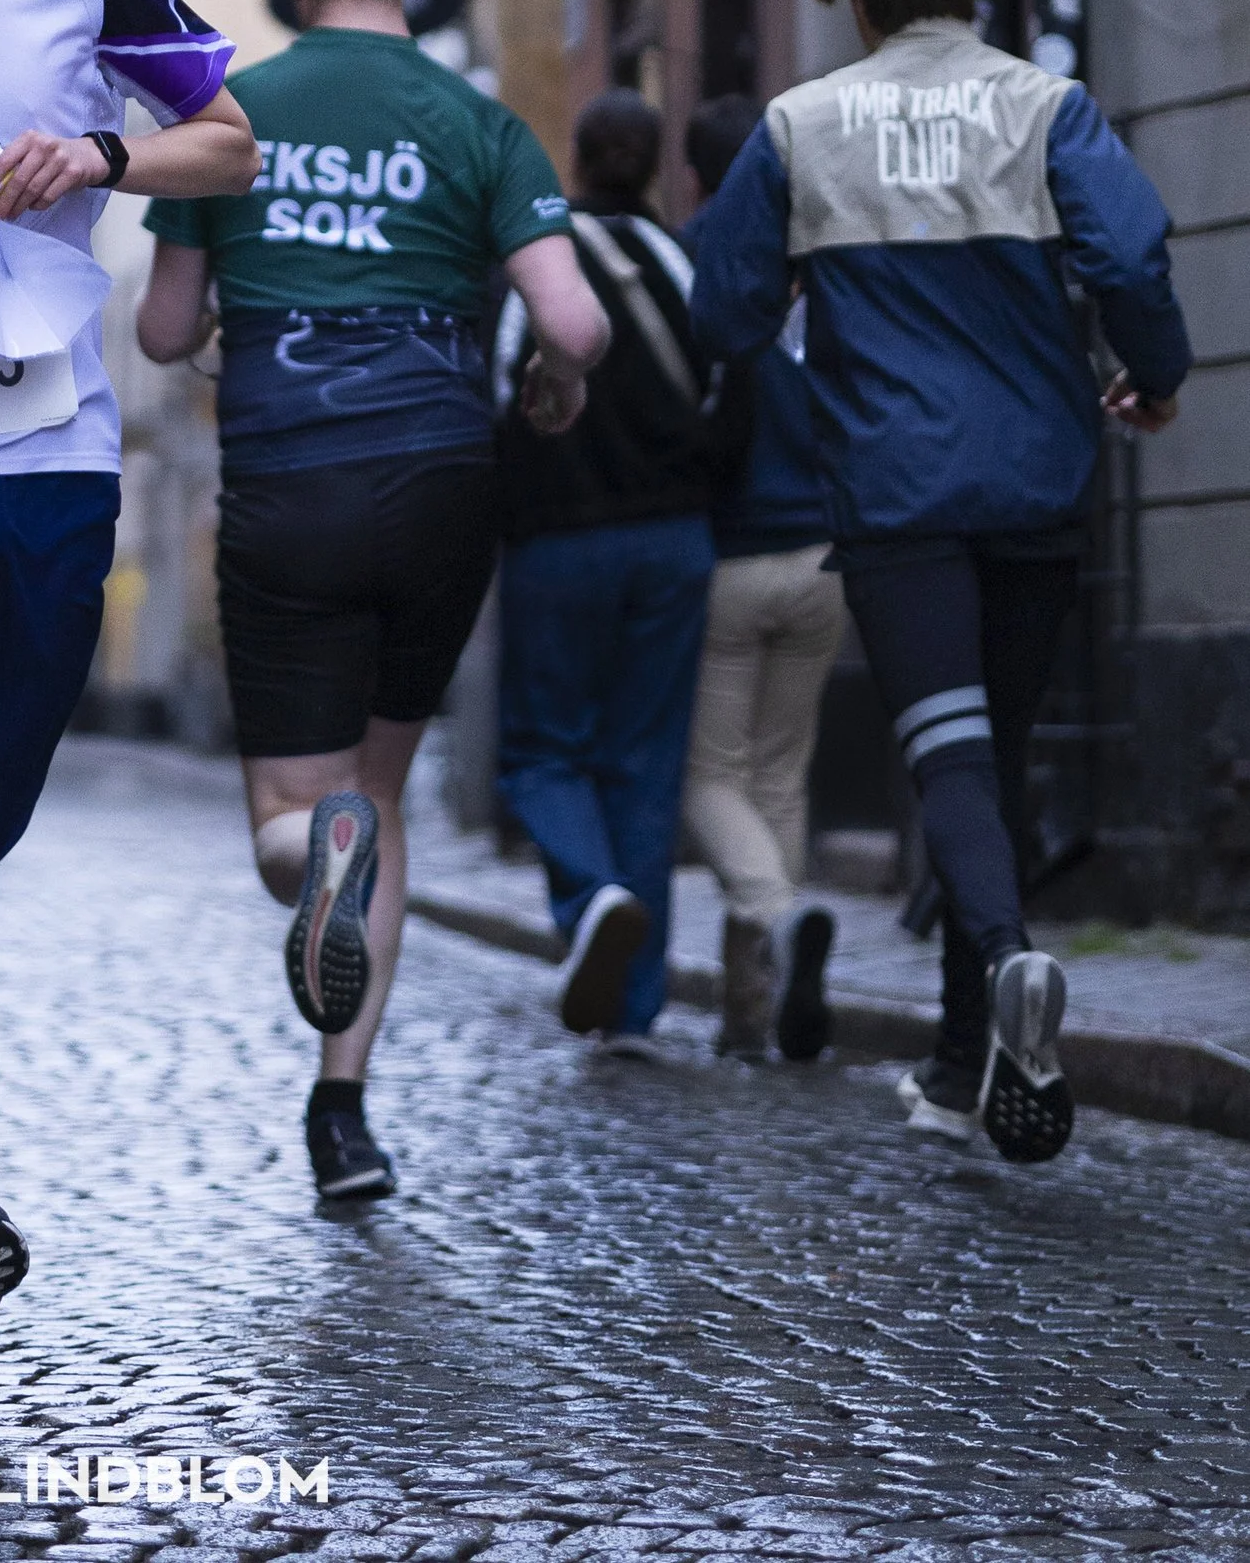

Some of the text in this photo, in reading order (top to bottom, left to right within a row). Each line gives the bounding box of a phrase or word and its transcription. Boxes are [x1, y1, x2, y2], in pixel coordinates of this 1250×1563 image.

[836, 78, 997, 137] YMR TRACK
[877, 117, 961, 188] CLUB
[262, 197, 394, 253] SOK
